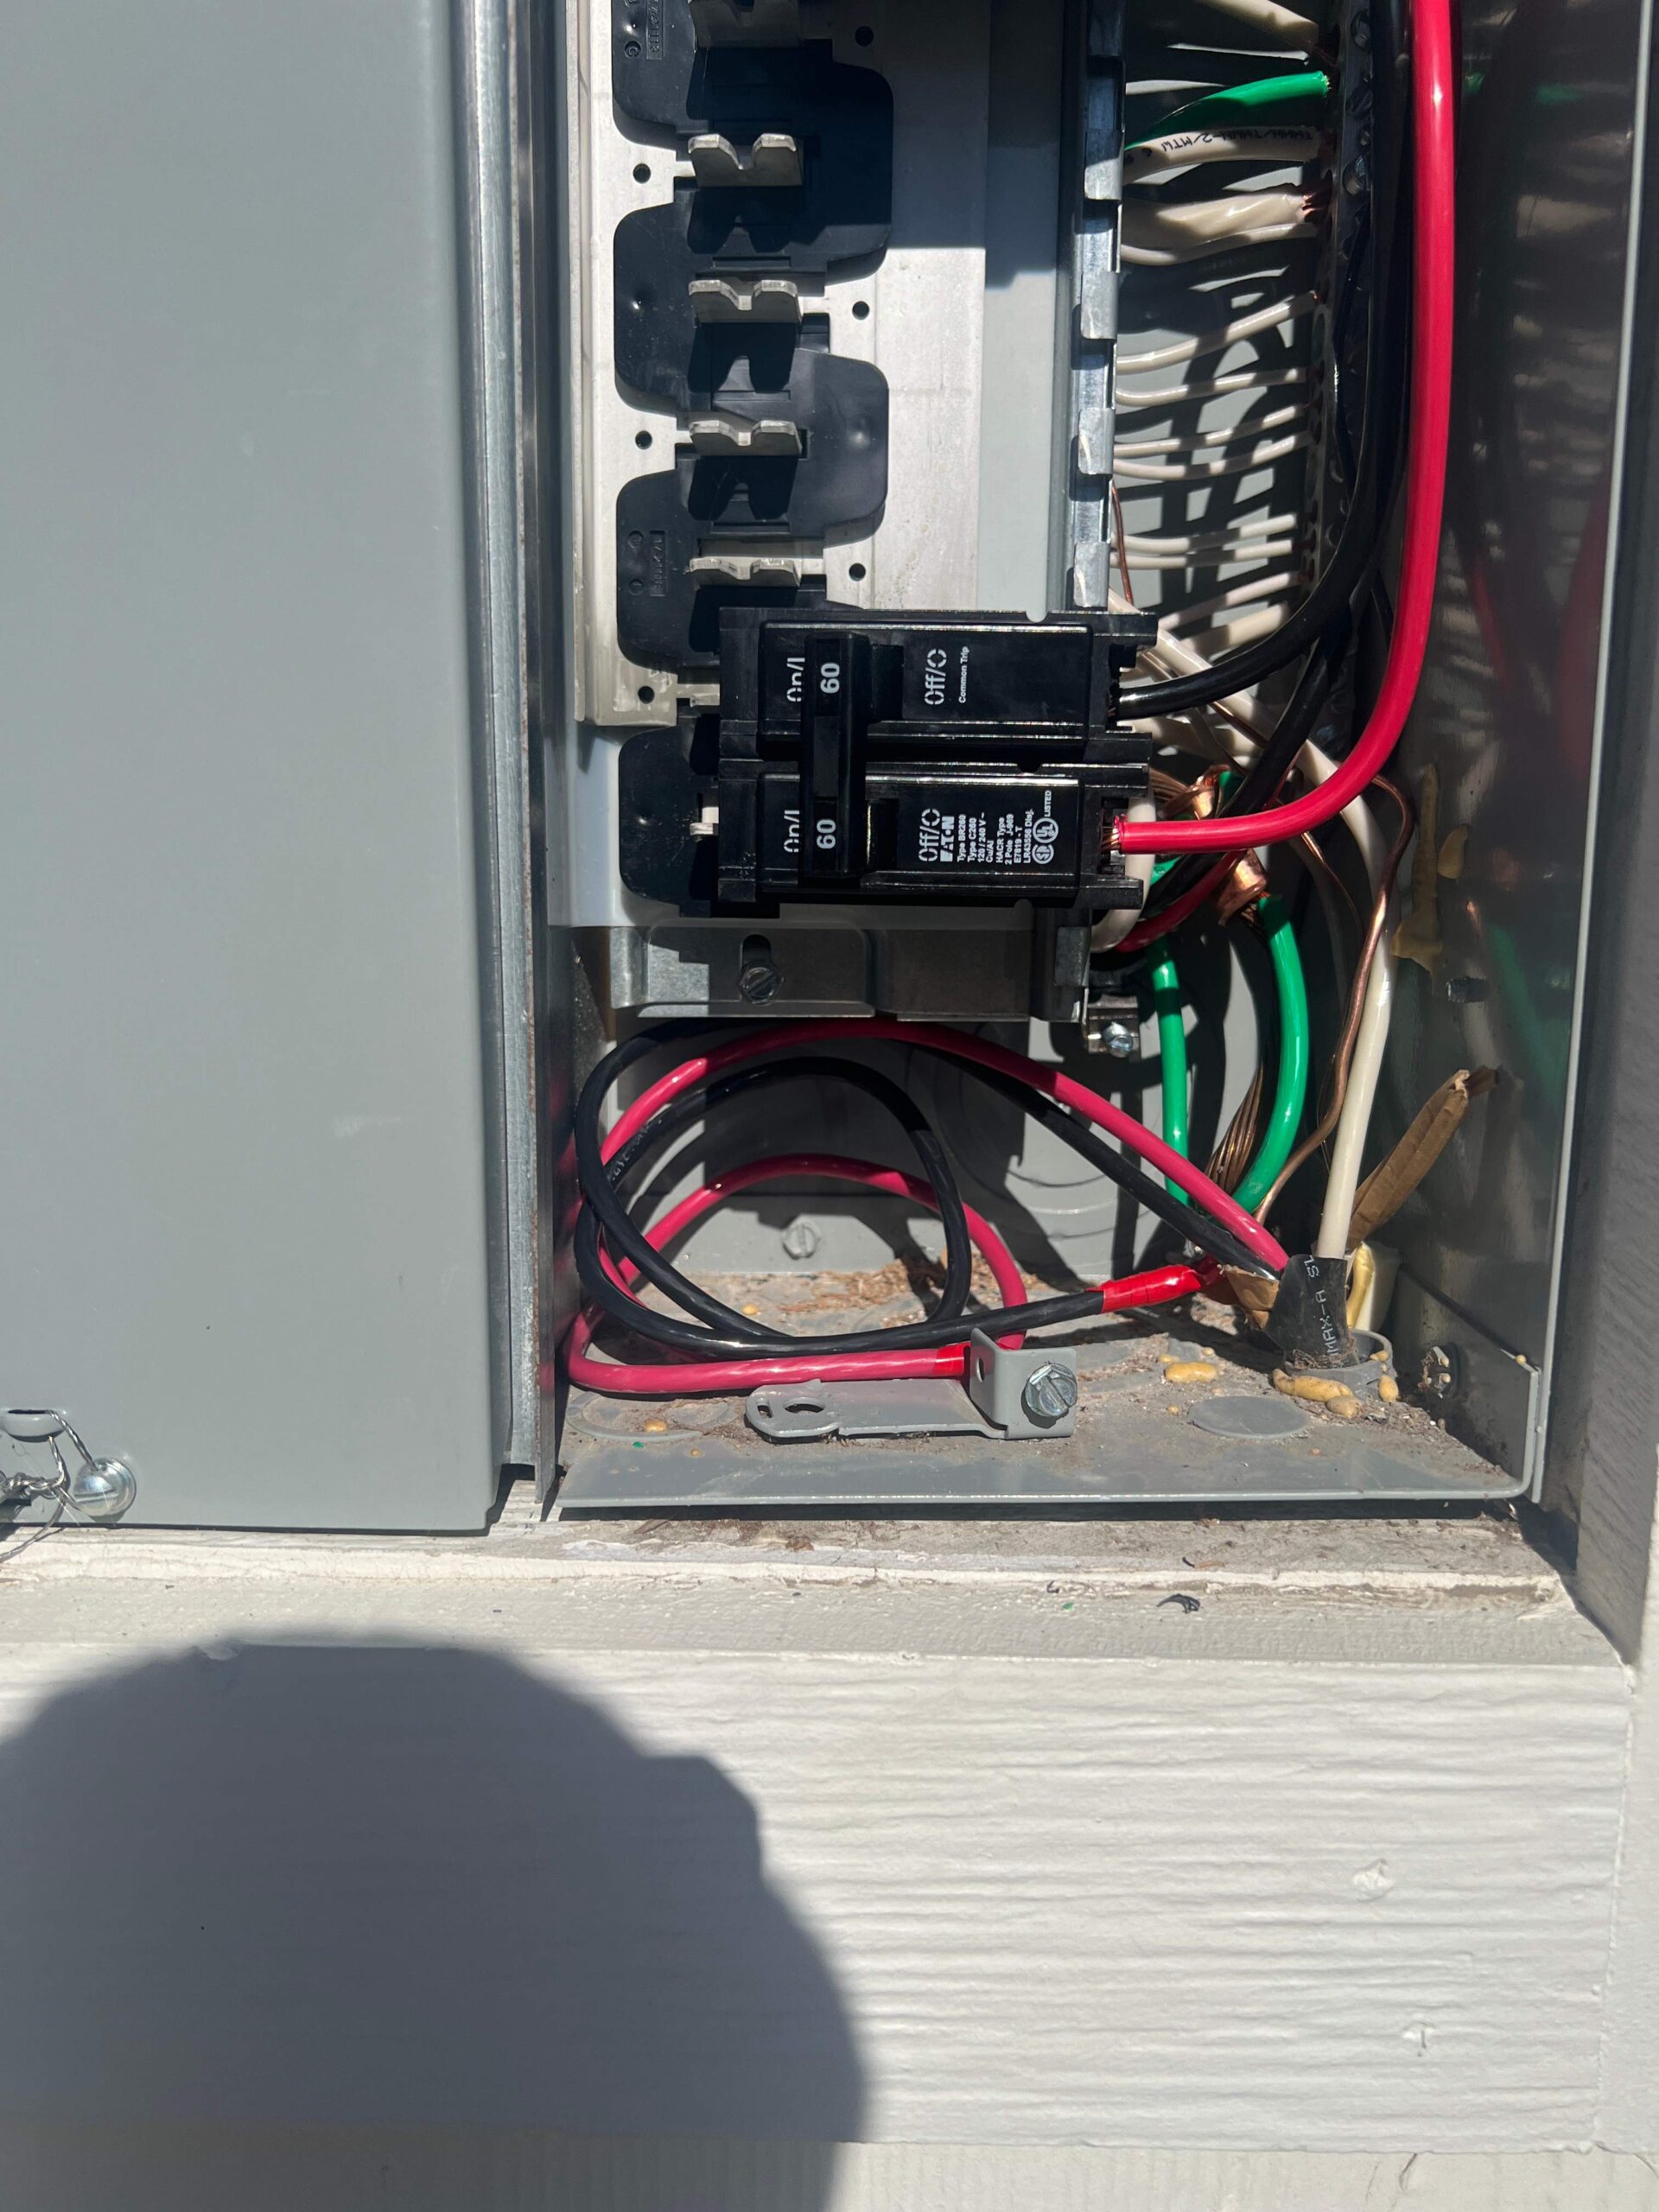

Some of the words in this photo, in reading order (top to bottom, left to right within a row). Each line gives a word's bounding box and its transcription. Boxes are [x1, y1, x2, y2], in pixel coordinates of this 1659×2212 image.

[960, 646, 969, 664] Trip
[820, 663, 840, 694] 60
[958, 664, 968, 703] Common
[816, 819, 836, 849] 60
[957, 814, 966, 841] BR260
[969, 817, 977, 840] C260
[997, 817, 1007, 837] Type
[957, 842, 967, 862] Type
[968, 842, 977, 862] Type
[995, 838, 1004, 863] HACR
